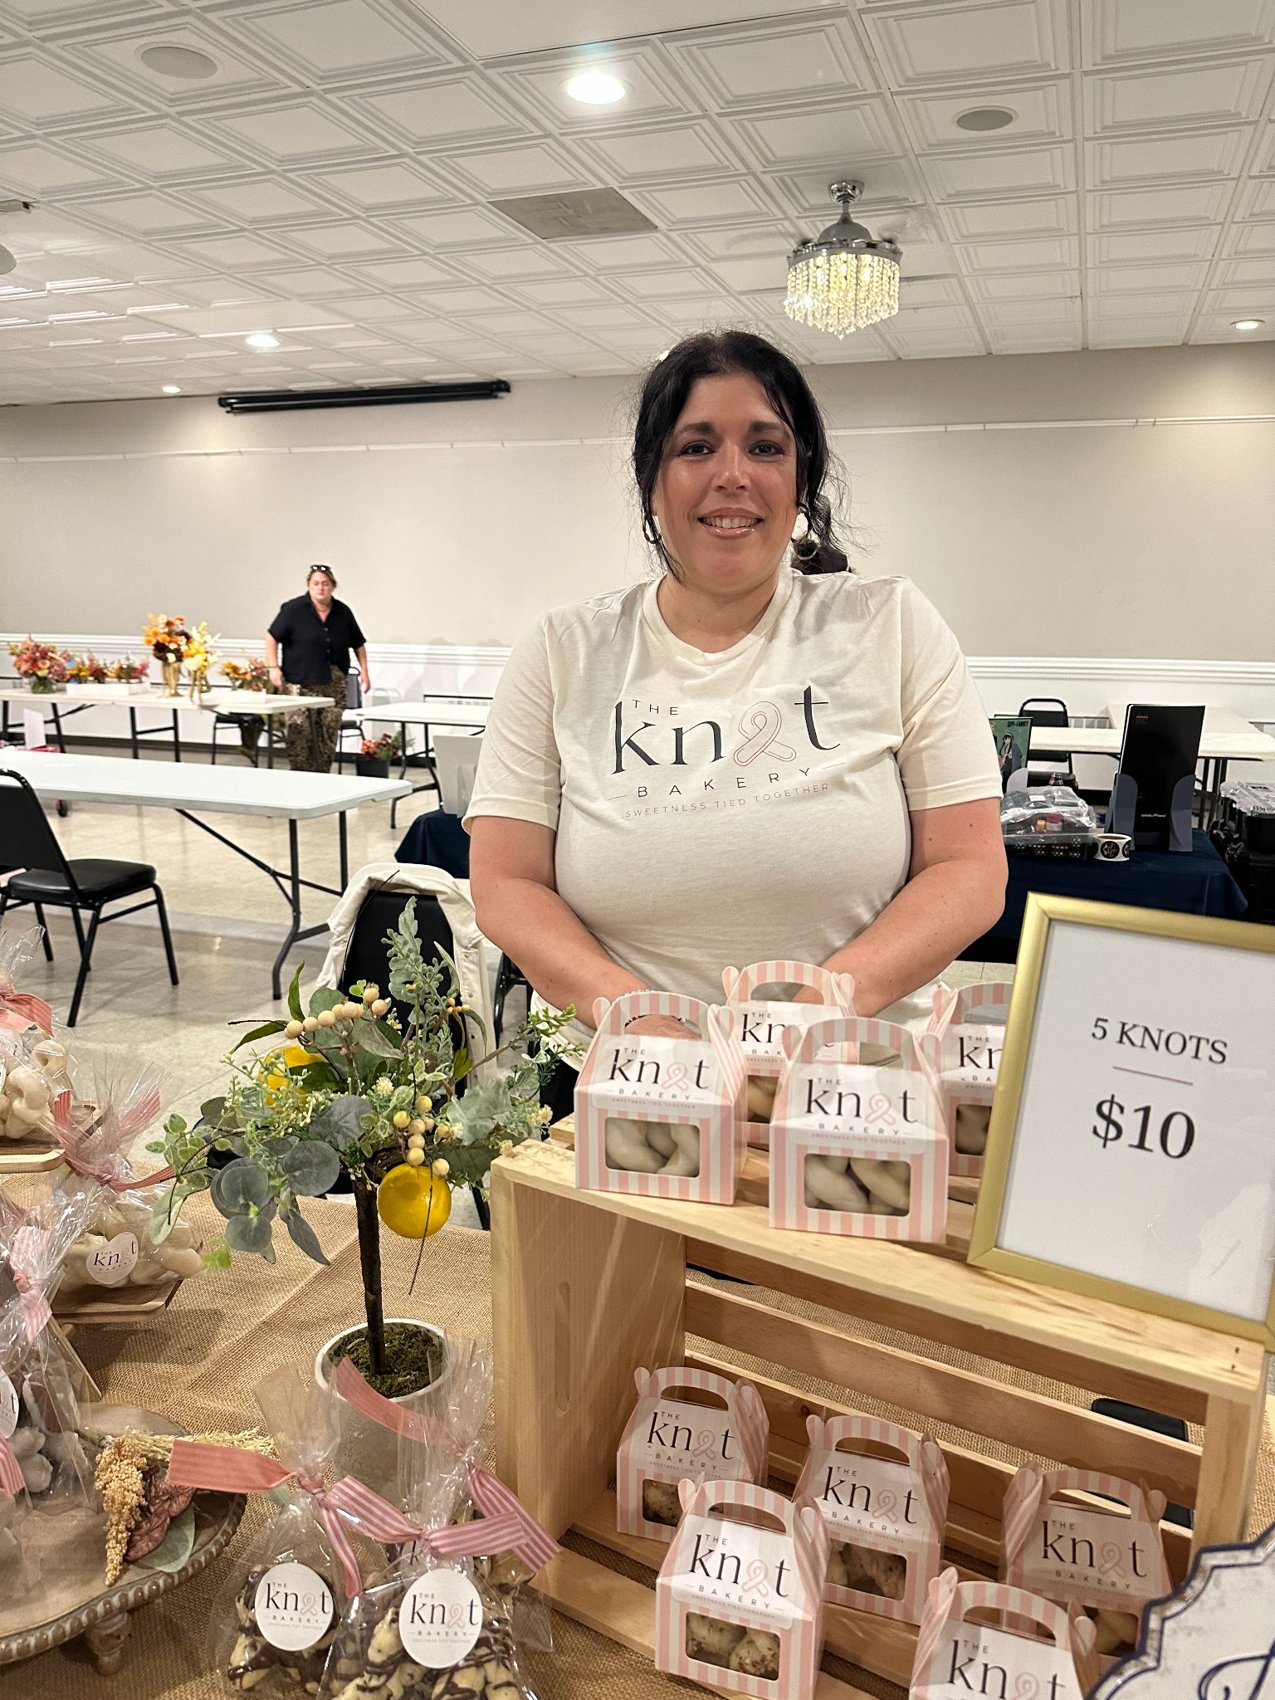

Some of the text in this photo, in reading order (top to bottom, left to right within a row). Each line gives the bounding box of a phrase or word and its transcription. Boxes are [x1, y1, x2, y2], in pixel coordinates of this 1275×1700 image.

[633, 699, 679, 716] THE
[637, 767, 810, 798] BAKERY
[625, 783, 830, 818] SWEETNESS TIED TOGETHER
[1091, 1017, 1228, 1065] 5 KNOTS
[624, 1047, 645, 1055] THE
[618, 1088, 691, 1101] BAKERY
[819, 1122, 899, 1136] BAKERY
[1092, 1093, 1195, 1160] $10
[660, 1411, 681, 1420] THE
[655, 1452, 717, 1470] BAKERY
[836, 1466, 858, 1477] THE
[831, 1511, 900, 1534] BAKERY
[1052, 1520, 1075, 1530] THE
[705, 1534, 728, 1546] THE
[1055, 1570, 1131, 1590] BAKERY
[698, 1584, 770, 1609] BAKERY
[962, 1639, 989, 1654] THE
